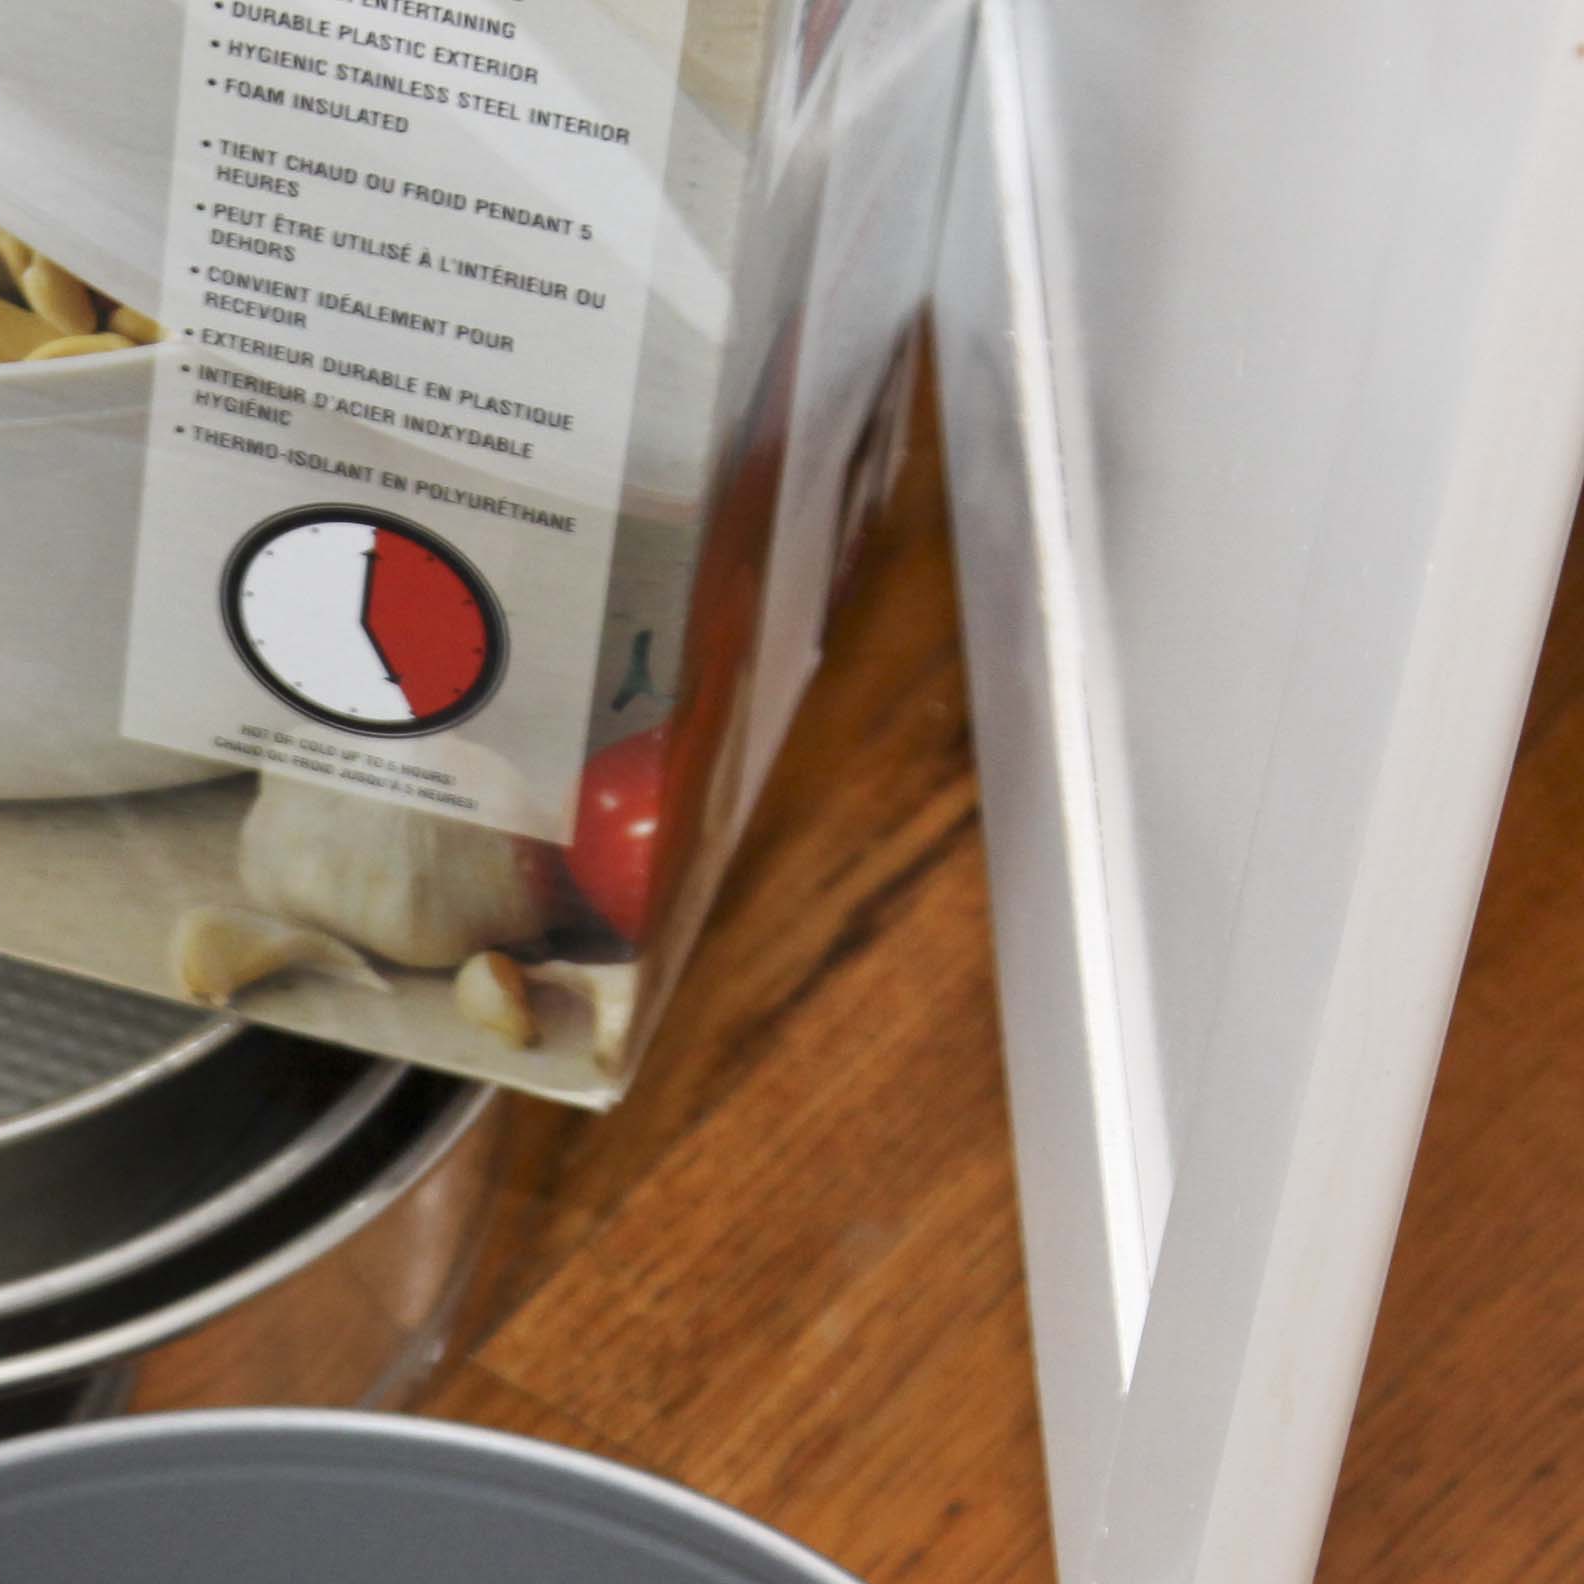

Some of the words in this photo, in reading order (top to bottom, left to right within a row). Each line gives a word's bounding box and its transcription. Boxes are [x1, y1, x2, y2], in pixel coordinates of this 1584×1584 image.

[232, 1, 331, 38] DURABLE
[337, 24, 426, 59] PLASTIC
[433, 46, 539, 84] EXTERIOR
[224, 77, 285, 105] FOAM
[292, 92, 409, 134] INSULATED
[227, 39, 328, 76] HYGIENIC
[335, 63, 450, 104] STAINLESS
[457, 91, 520, 122] STEEL
[528, 107, 630, 145] INTERIOR
[215, 164, 300, 198] HEURES
[219, 139, 279, 167] TIENT
[285, 154, 358, 184] CHAUD
[365, 172, 395, 194] OU
[402, 181, 467, 210] FROID
[474, 198, 574, 236] PENDANT
[580, 224, 593, 241] 5
[209, 228, 296, 263] DEHORS
[213, 202, 266, 228] PEUT
[272, 212, 325, 243] ÊTRE
[332, 230, 412, 263] UTILISÉ
[439, 255, 568, 301] L'INTÉRIEUR
[575, 288, 606, 310] OU
[204, 291, 307, 329] RECEVOIR
[207, 265, 312, 302] CONVIENT
[317, 291, 448, 337] IDÉALEMENT
[455, 324, 515, 352] POUR
[197, 364, 306, 403] INTERIEUR
[312, 391, 395, 426] D'ACIER
[402, 413, 534, 459] INOXYDABLE
[201, 328, 314, 368] EXTERIEUR
[322, 356, 418, 393] DURABLE
[424, 381, 452, 401] EN
[458, 389, 574, 431] PLASTIQUE
[192, 425, 375, 483] THERMO-ISOLANT
[381, 470, 408, 492] EN
[414, 478, 577, 533] POLYURÉTHANE
